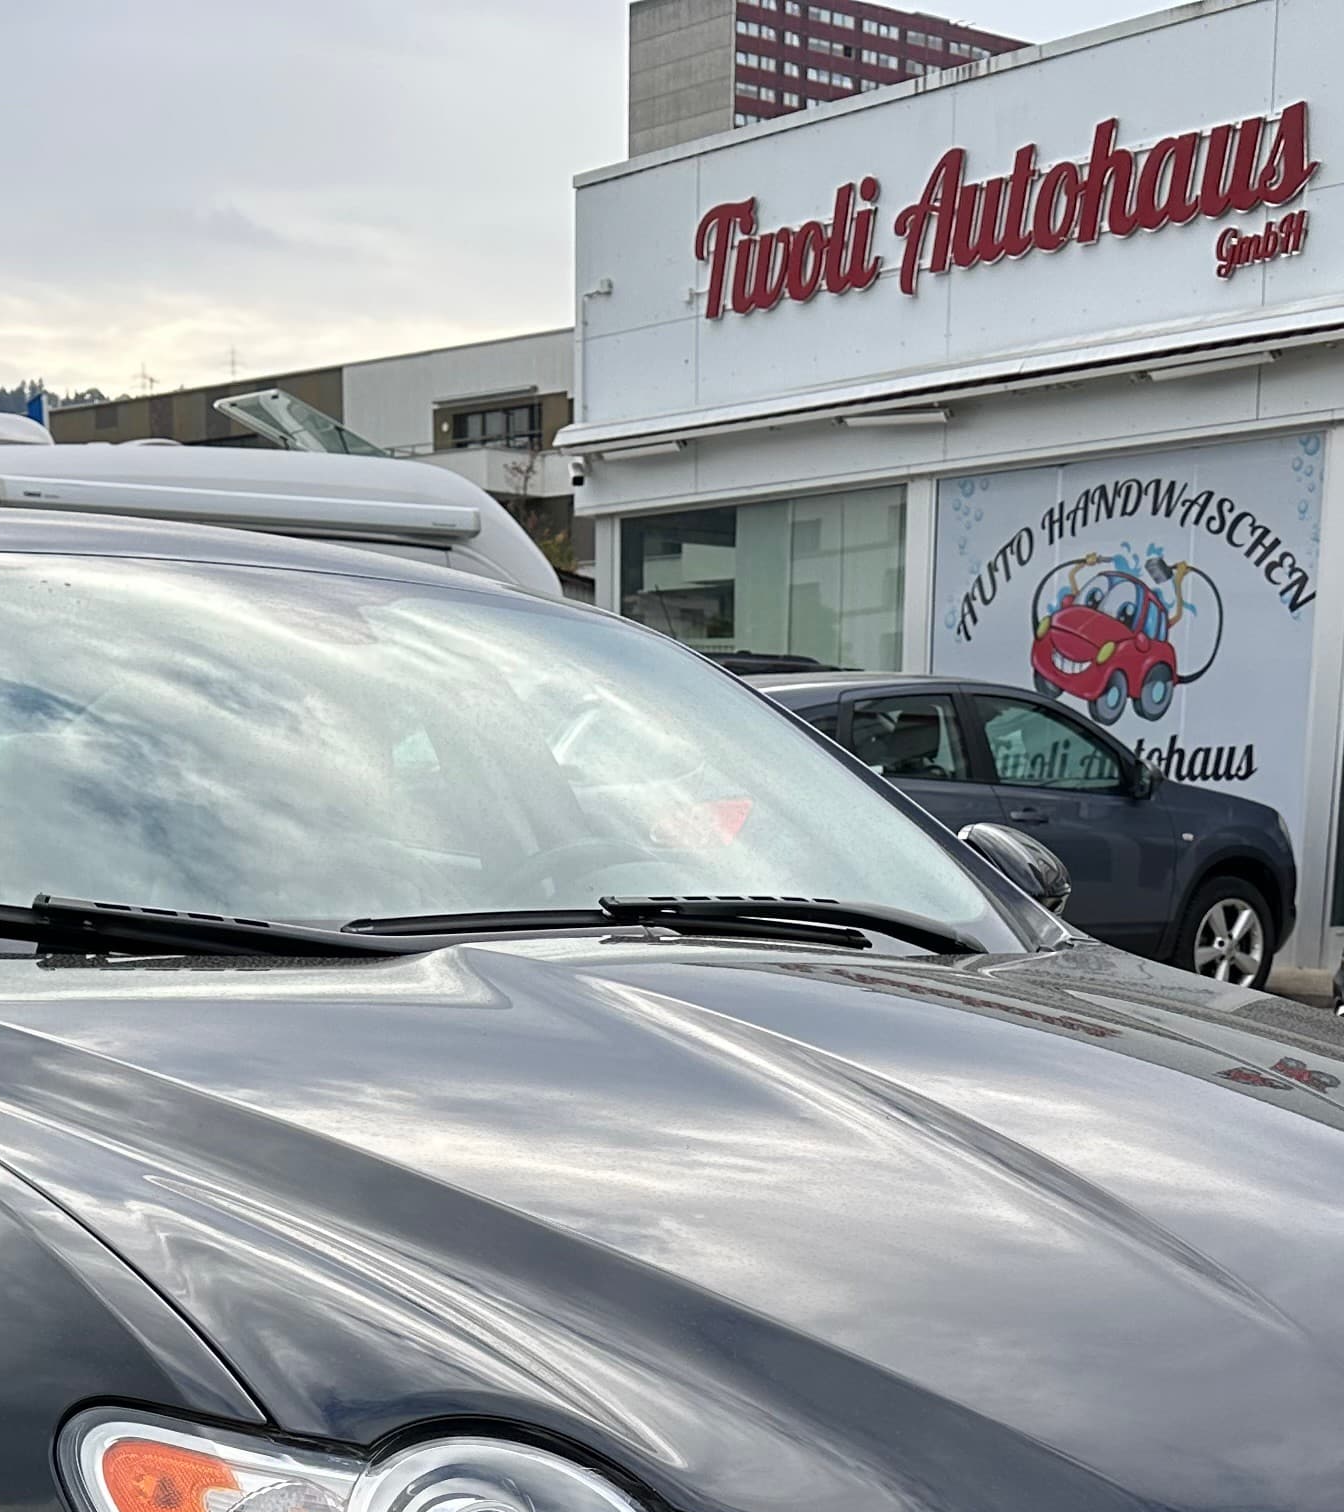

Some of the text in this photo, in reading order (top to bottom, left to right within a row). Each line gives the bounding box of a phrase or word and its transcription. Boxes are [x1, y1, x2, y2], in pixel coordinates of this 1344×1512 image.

[695, 101, 1319, 320] Tivoli Autohaus
[1216, 208, 1309, 279] GmbH
[957, 478, 1318, 642] AUTO HANDWASCHEN
